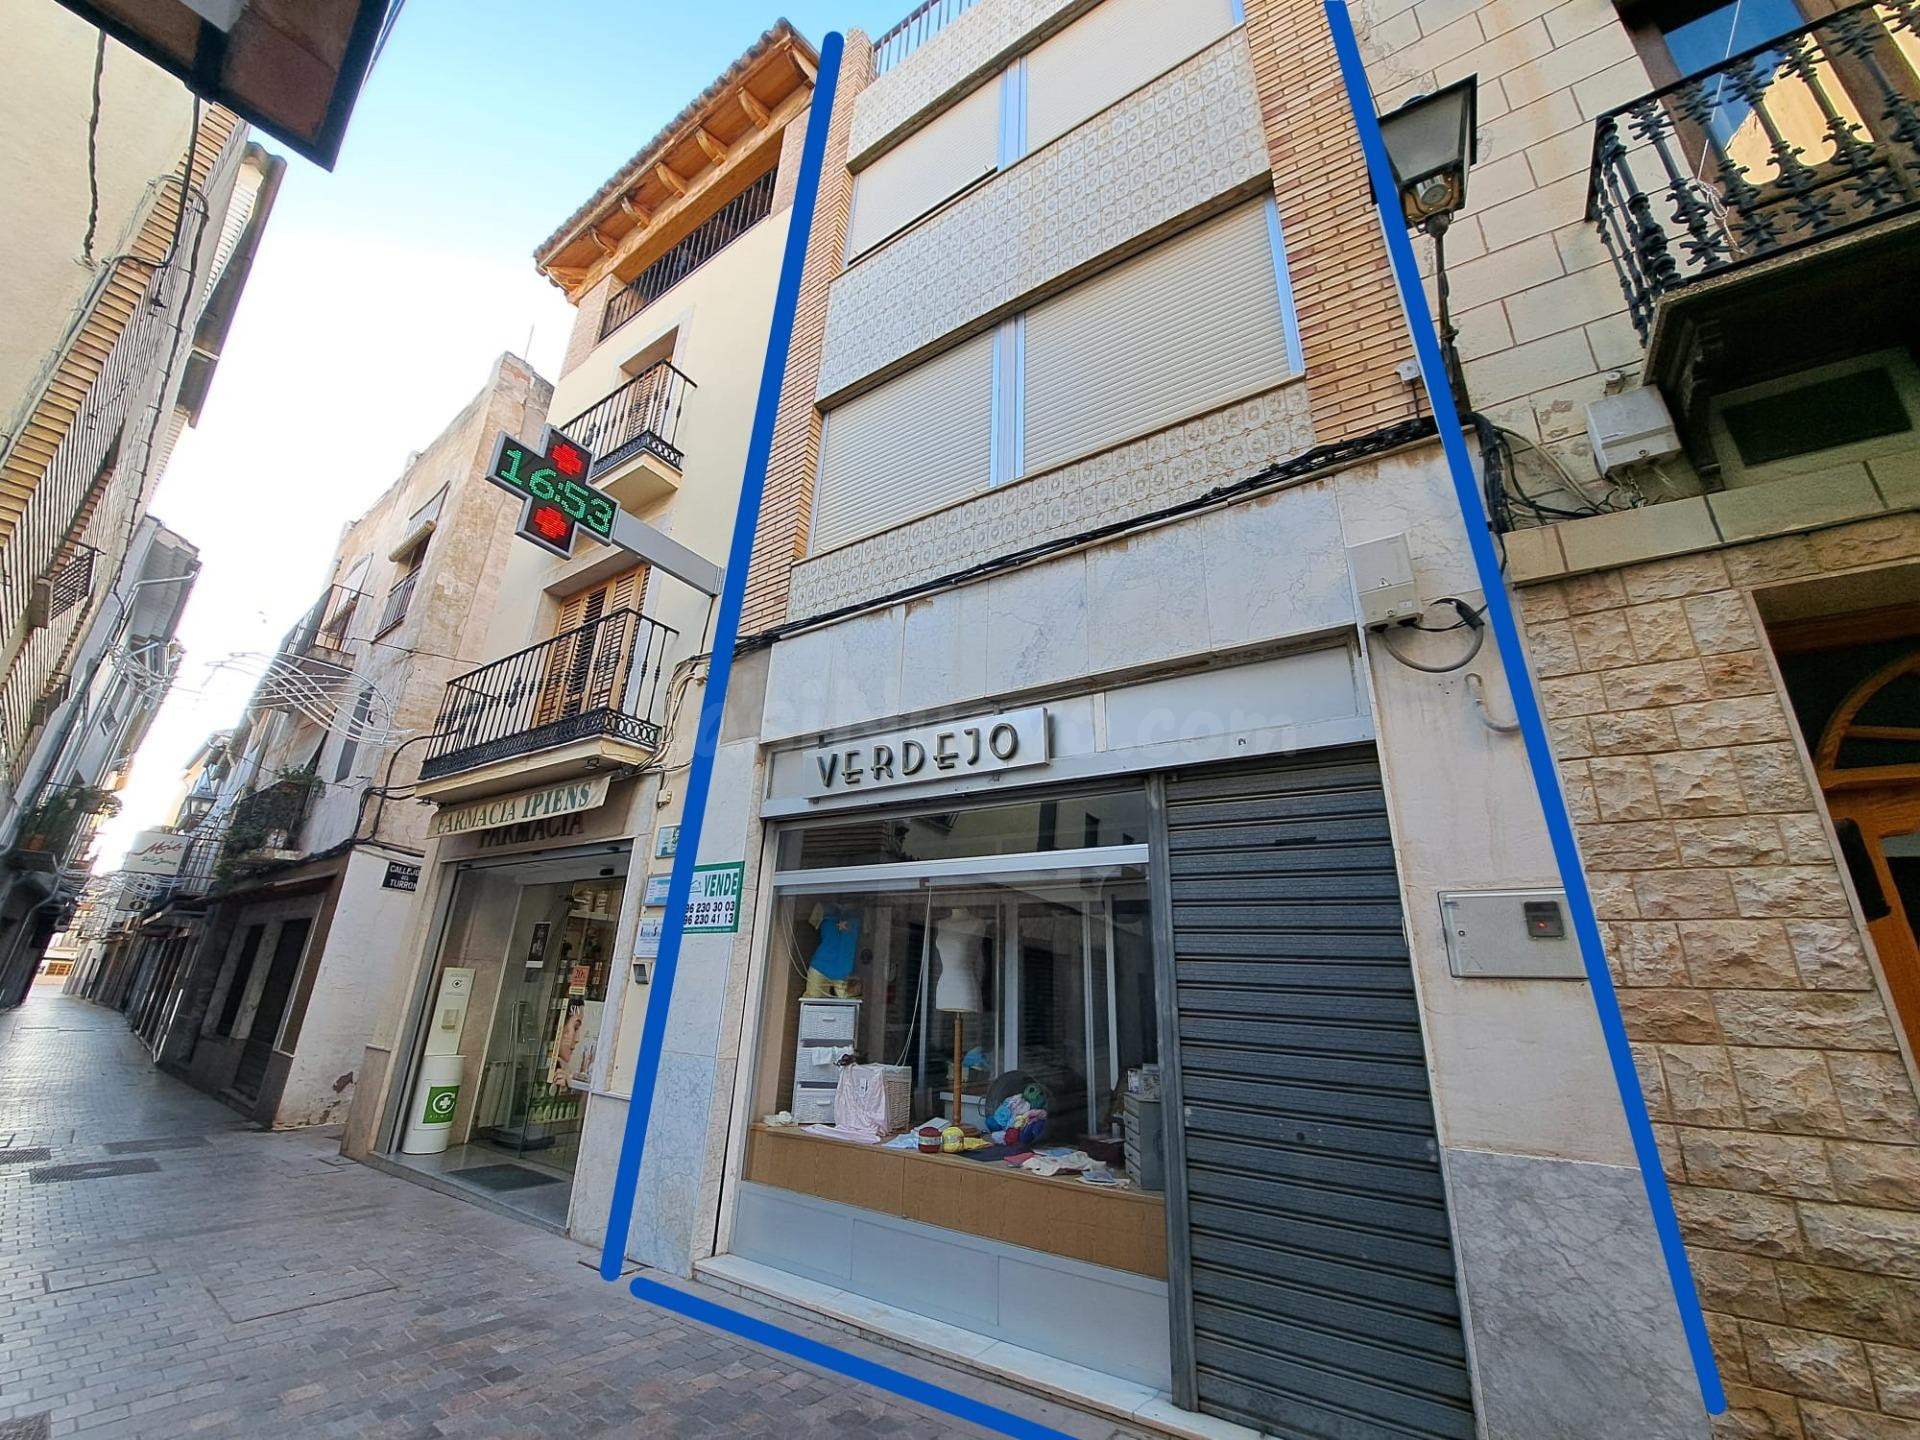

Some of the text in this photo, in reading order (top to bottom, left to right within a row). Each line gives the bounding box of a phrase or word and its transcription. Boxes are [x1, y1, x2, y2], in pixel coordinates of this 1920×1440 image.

[500, 448, 613, 533] 16:53
[816, 722, 1019, 788] VERDEJO
[436, 781, 592, 834] FARMACIA IPIENS
[390, 864, 420, 877] CALLEJO
[703, 872, 739, 897] VENDE
[683, 912, 734, 925] 96 230 41 13
[685, 900, 736, 914] 96 230 30 03
